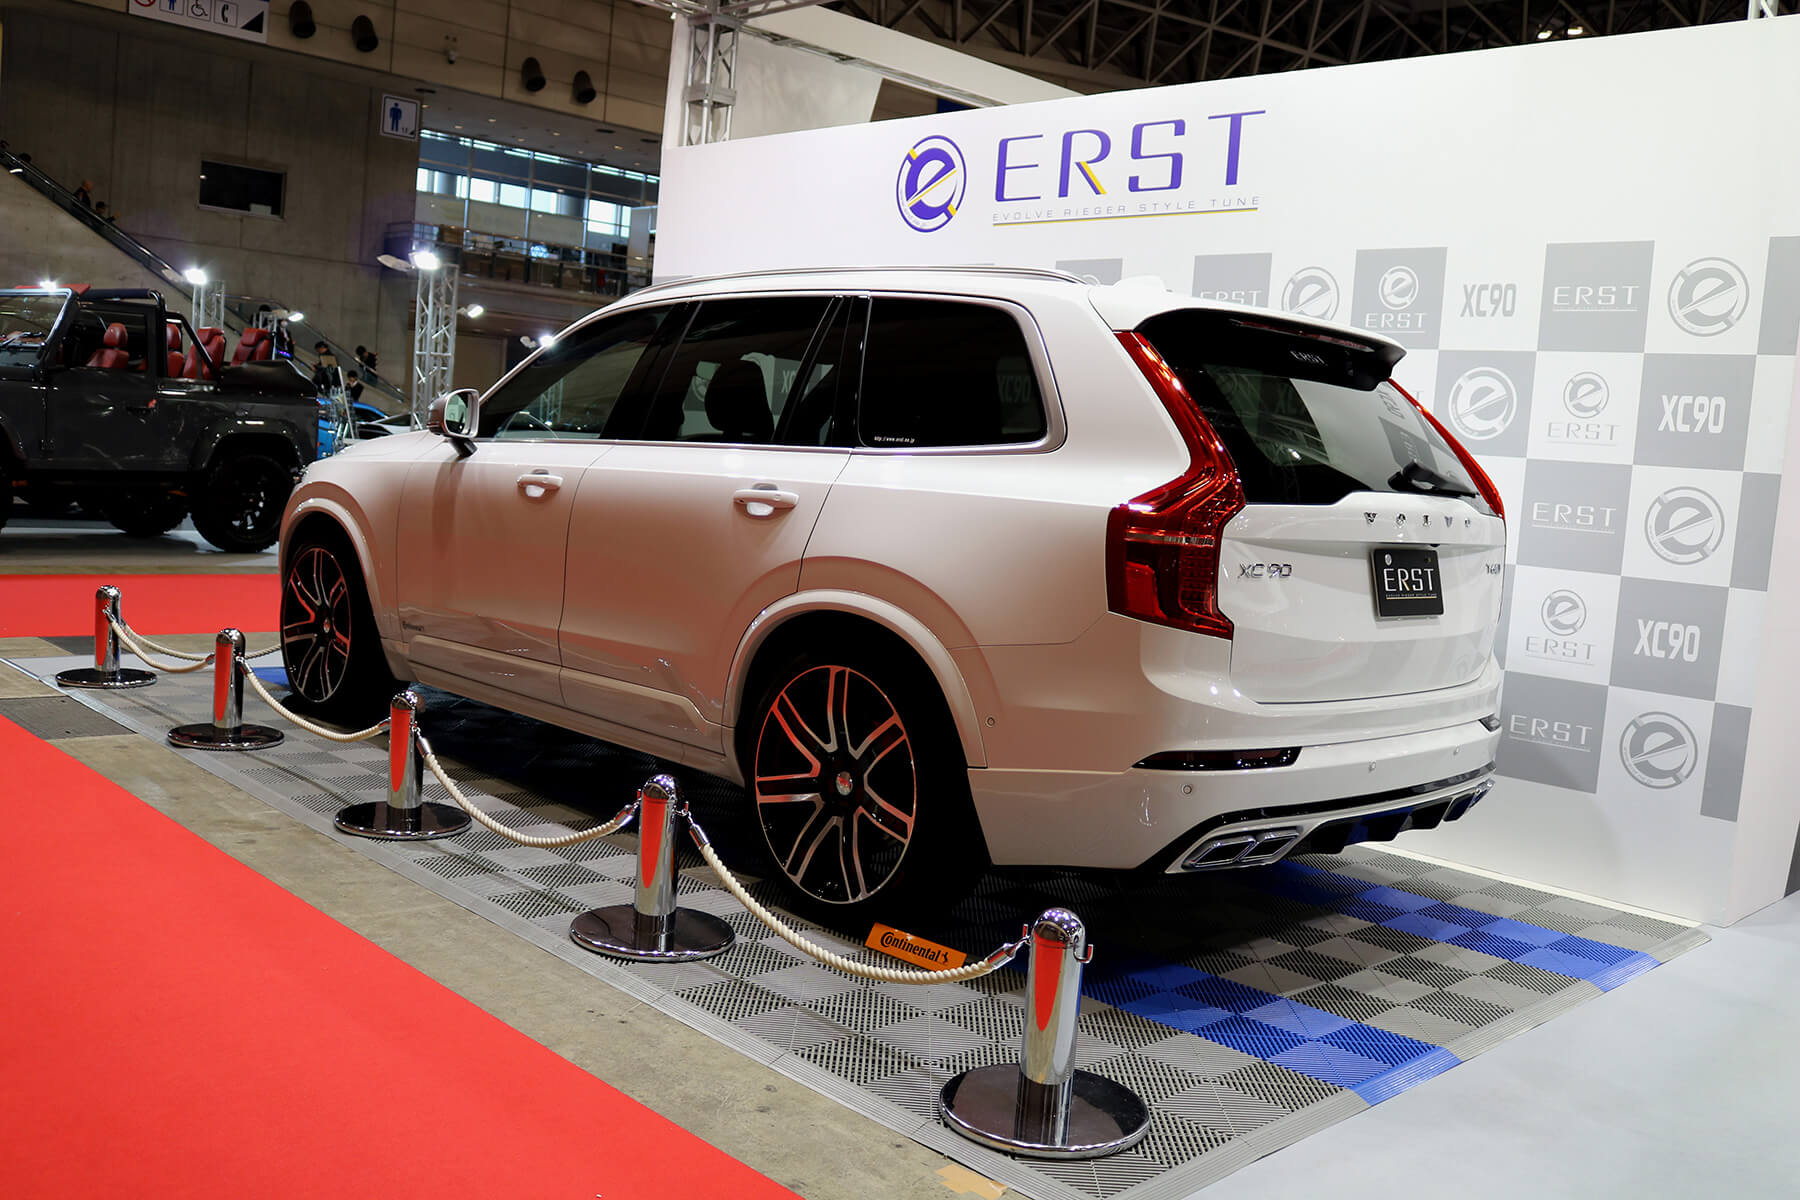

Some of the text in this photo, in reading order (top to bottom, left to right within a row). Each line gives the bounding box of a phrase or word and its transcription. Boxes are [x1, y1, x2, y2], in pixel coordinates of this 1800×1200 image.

[995, 110, 1266, 202] ERST
[992, 196, 1260, 222] EVOLVE RIEGER STYLE TUNE
[1460, 283, 1517, 318] XC90
[1552, 285, 1640, 305] ERST
[1364, 312, 1428, 329] ERST
[1658, 394, 1726, 434] XC90
[1547, 421, 1622, 442] ERST
[1532, 502, 1617, 527] ERST
[1383, 568, 1434, 591] ERST
[1526, 636, 1596, 660] ERST
[1633, 619, 1701, 662] XC90
[1510, 714, 1593, 745] ERST
[880, 931, 941, 962] Continental
